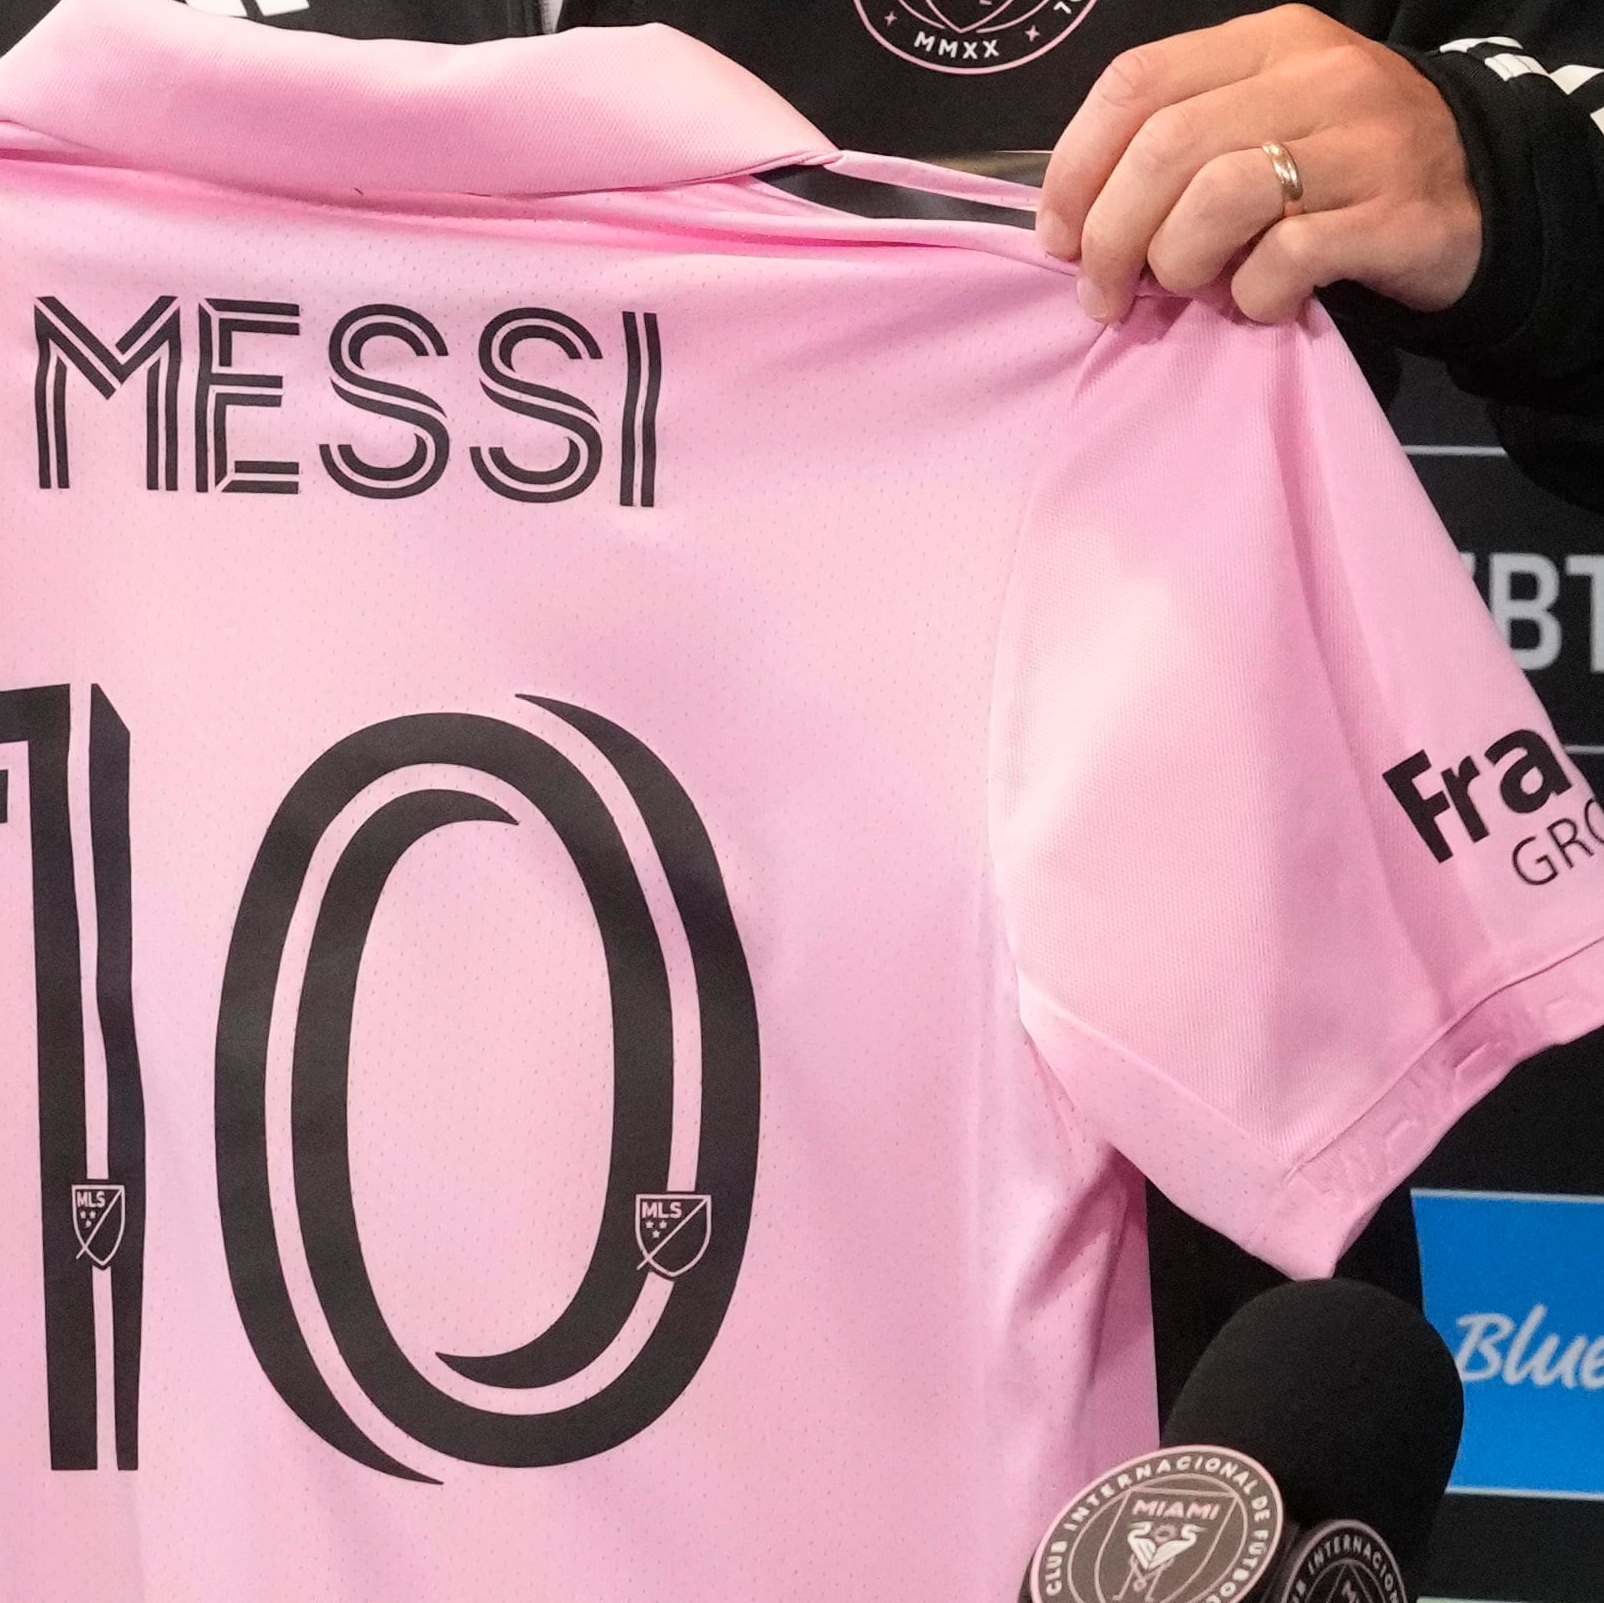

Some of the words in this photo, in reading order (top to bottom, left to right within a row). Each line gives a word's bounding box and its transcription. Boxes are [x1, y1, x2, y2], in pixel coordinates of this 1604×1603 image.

[913, 30, 1000, 59] MMXX
[34, 295, 663, 509] MESSI
[77, 1191, 106, 1208] MLS
[641, 1201, 682, 1219] MLS
[1131, 1499, 1220, 1520] MIAMI
[1045, 1540, 1068, 1596] CLUB
[1063, 1455, 1258, 1532] INTERNACIONAL
[1251, 1495, 1271, 1524] DE
